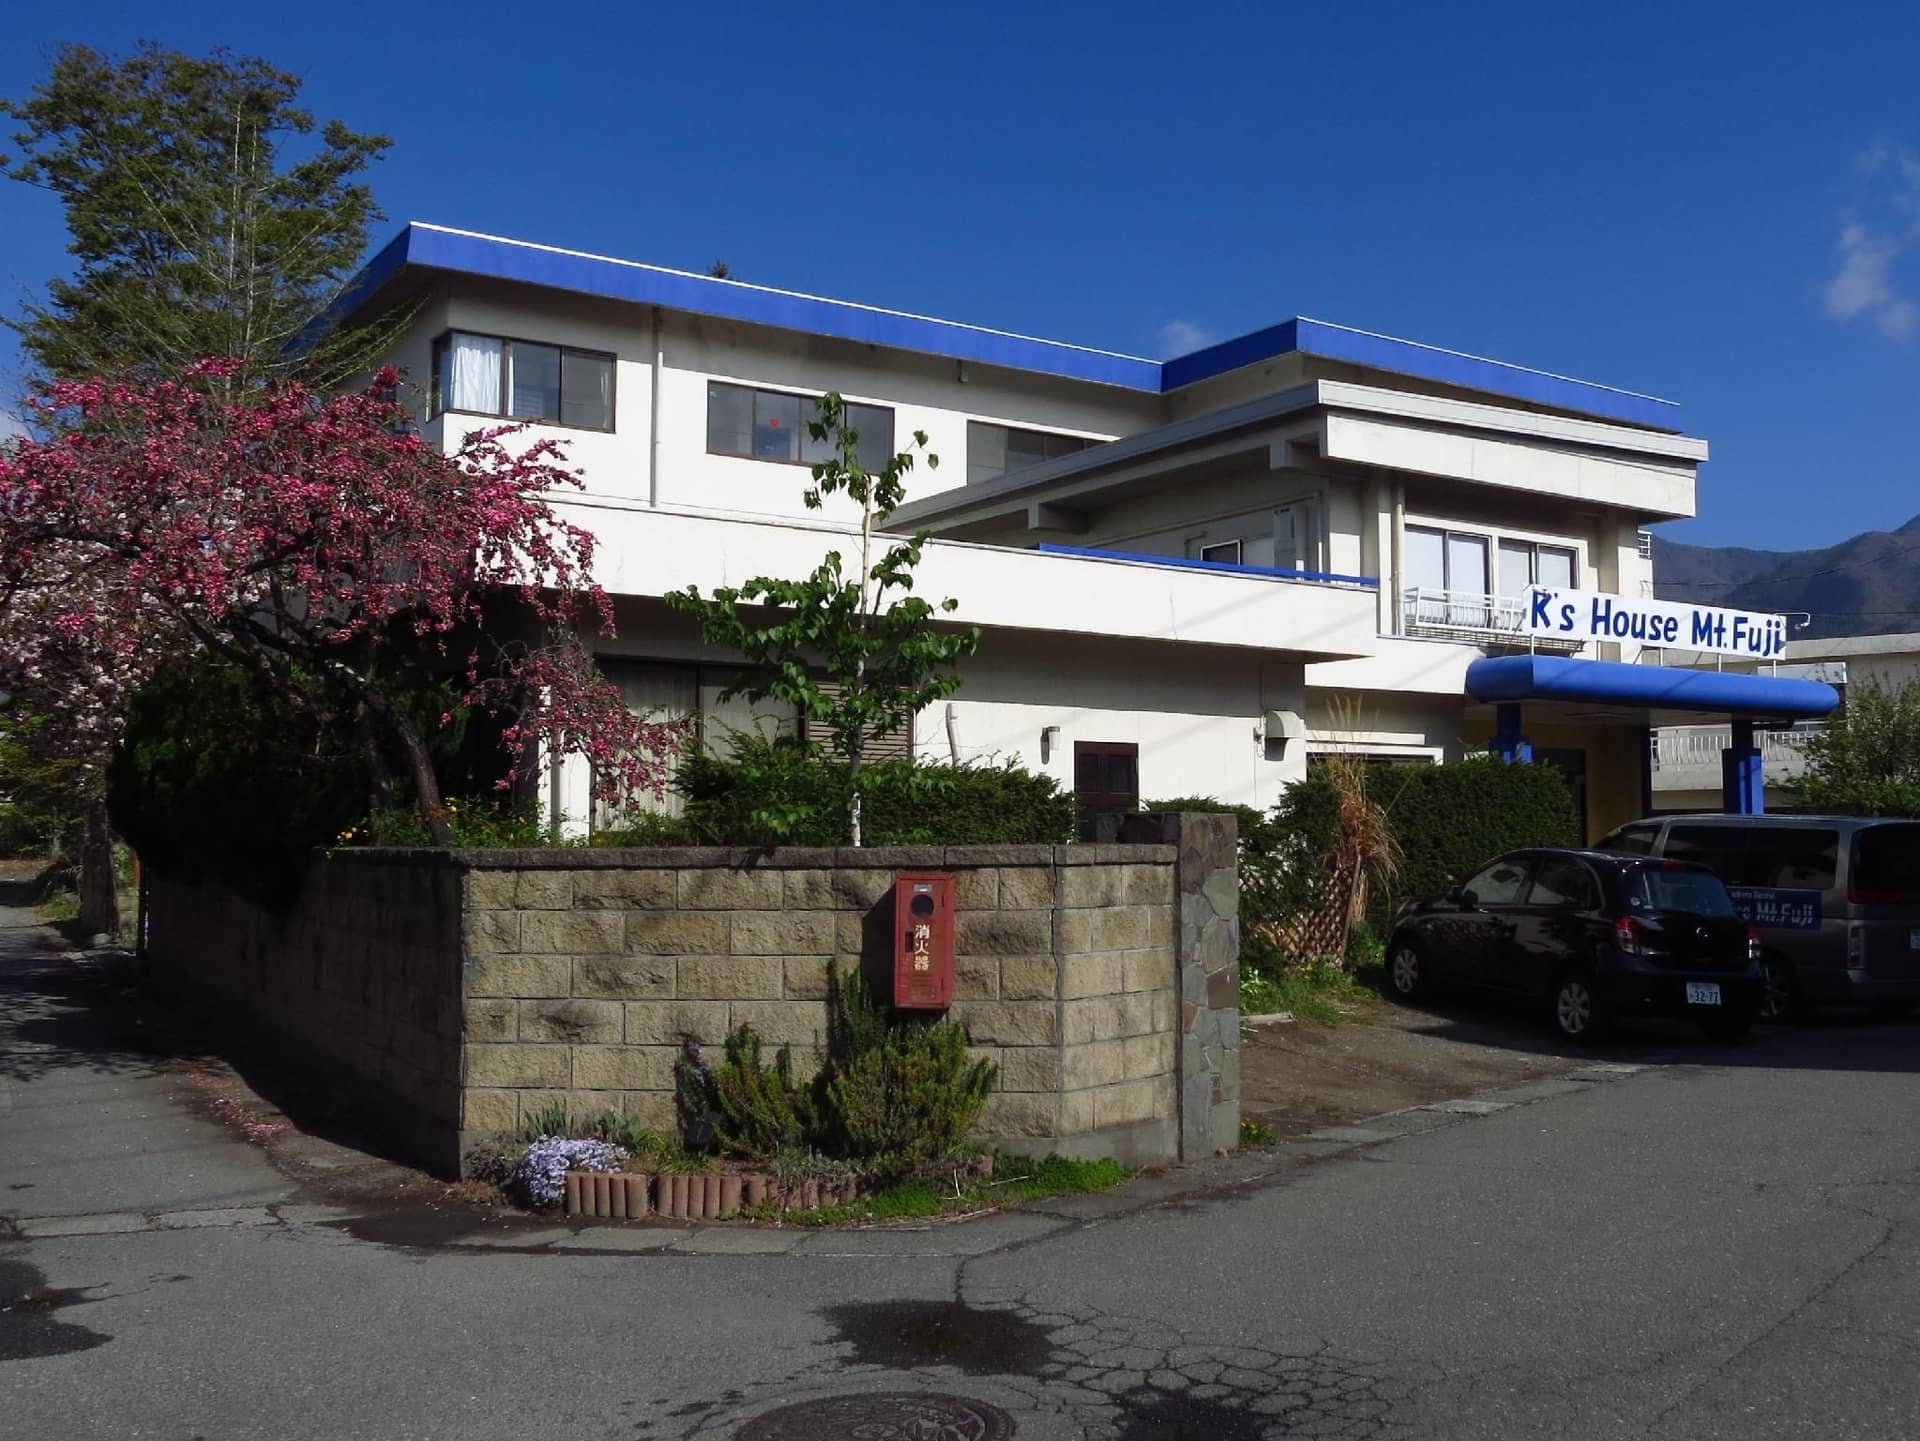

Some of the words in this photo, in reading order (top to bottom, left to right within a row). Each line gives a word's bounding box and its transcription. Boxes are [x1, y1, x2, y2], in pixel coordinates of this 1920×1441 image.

[1531, 590, 1575, 631] K's
[1591, 598, 1678, 642] House
[914, 924, 930, 971] 消火器
